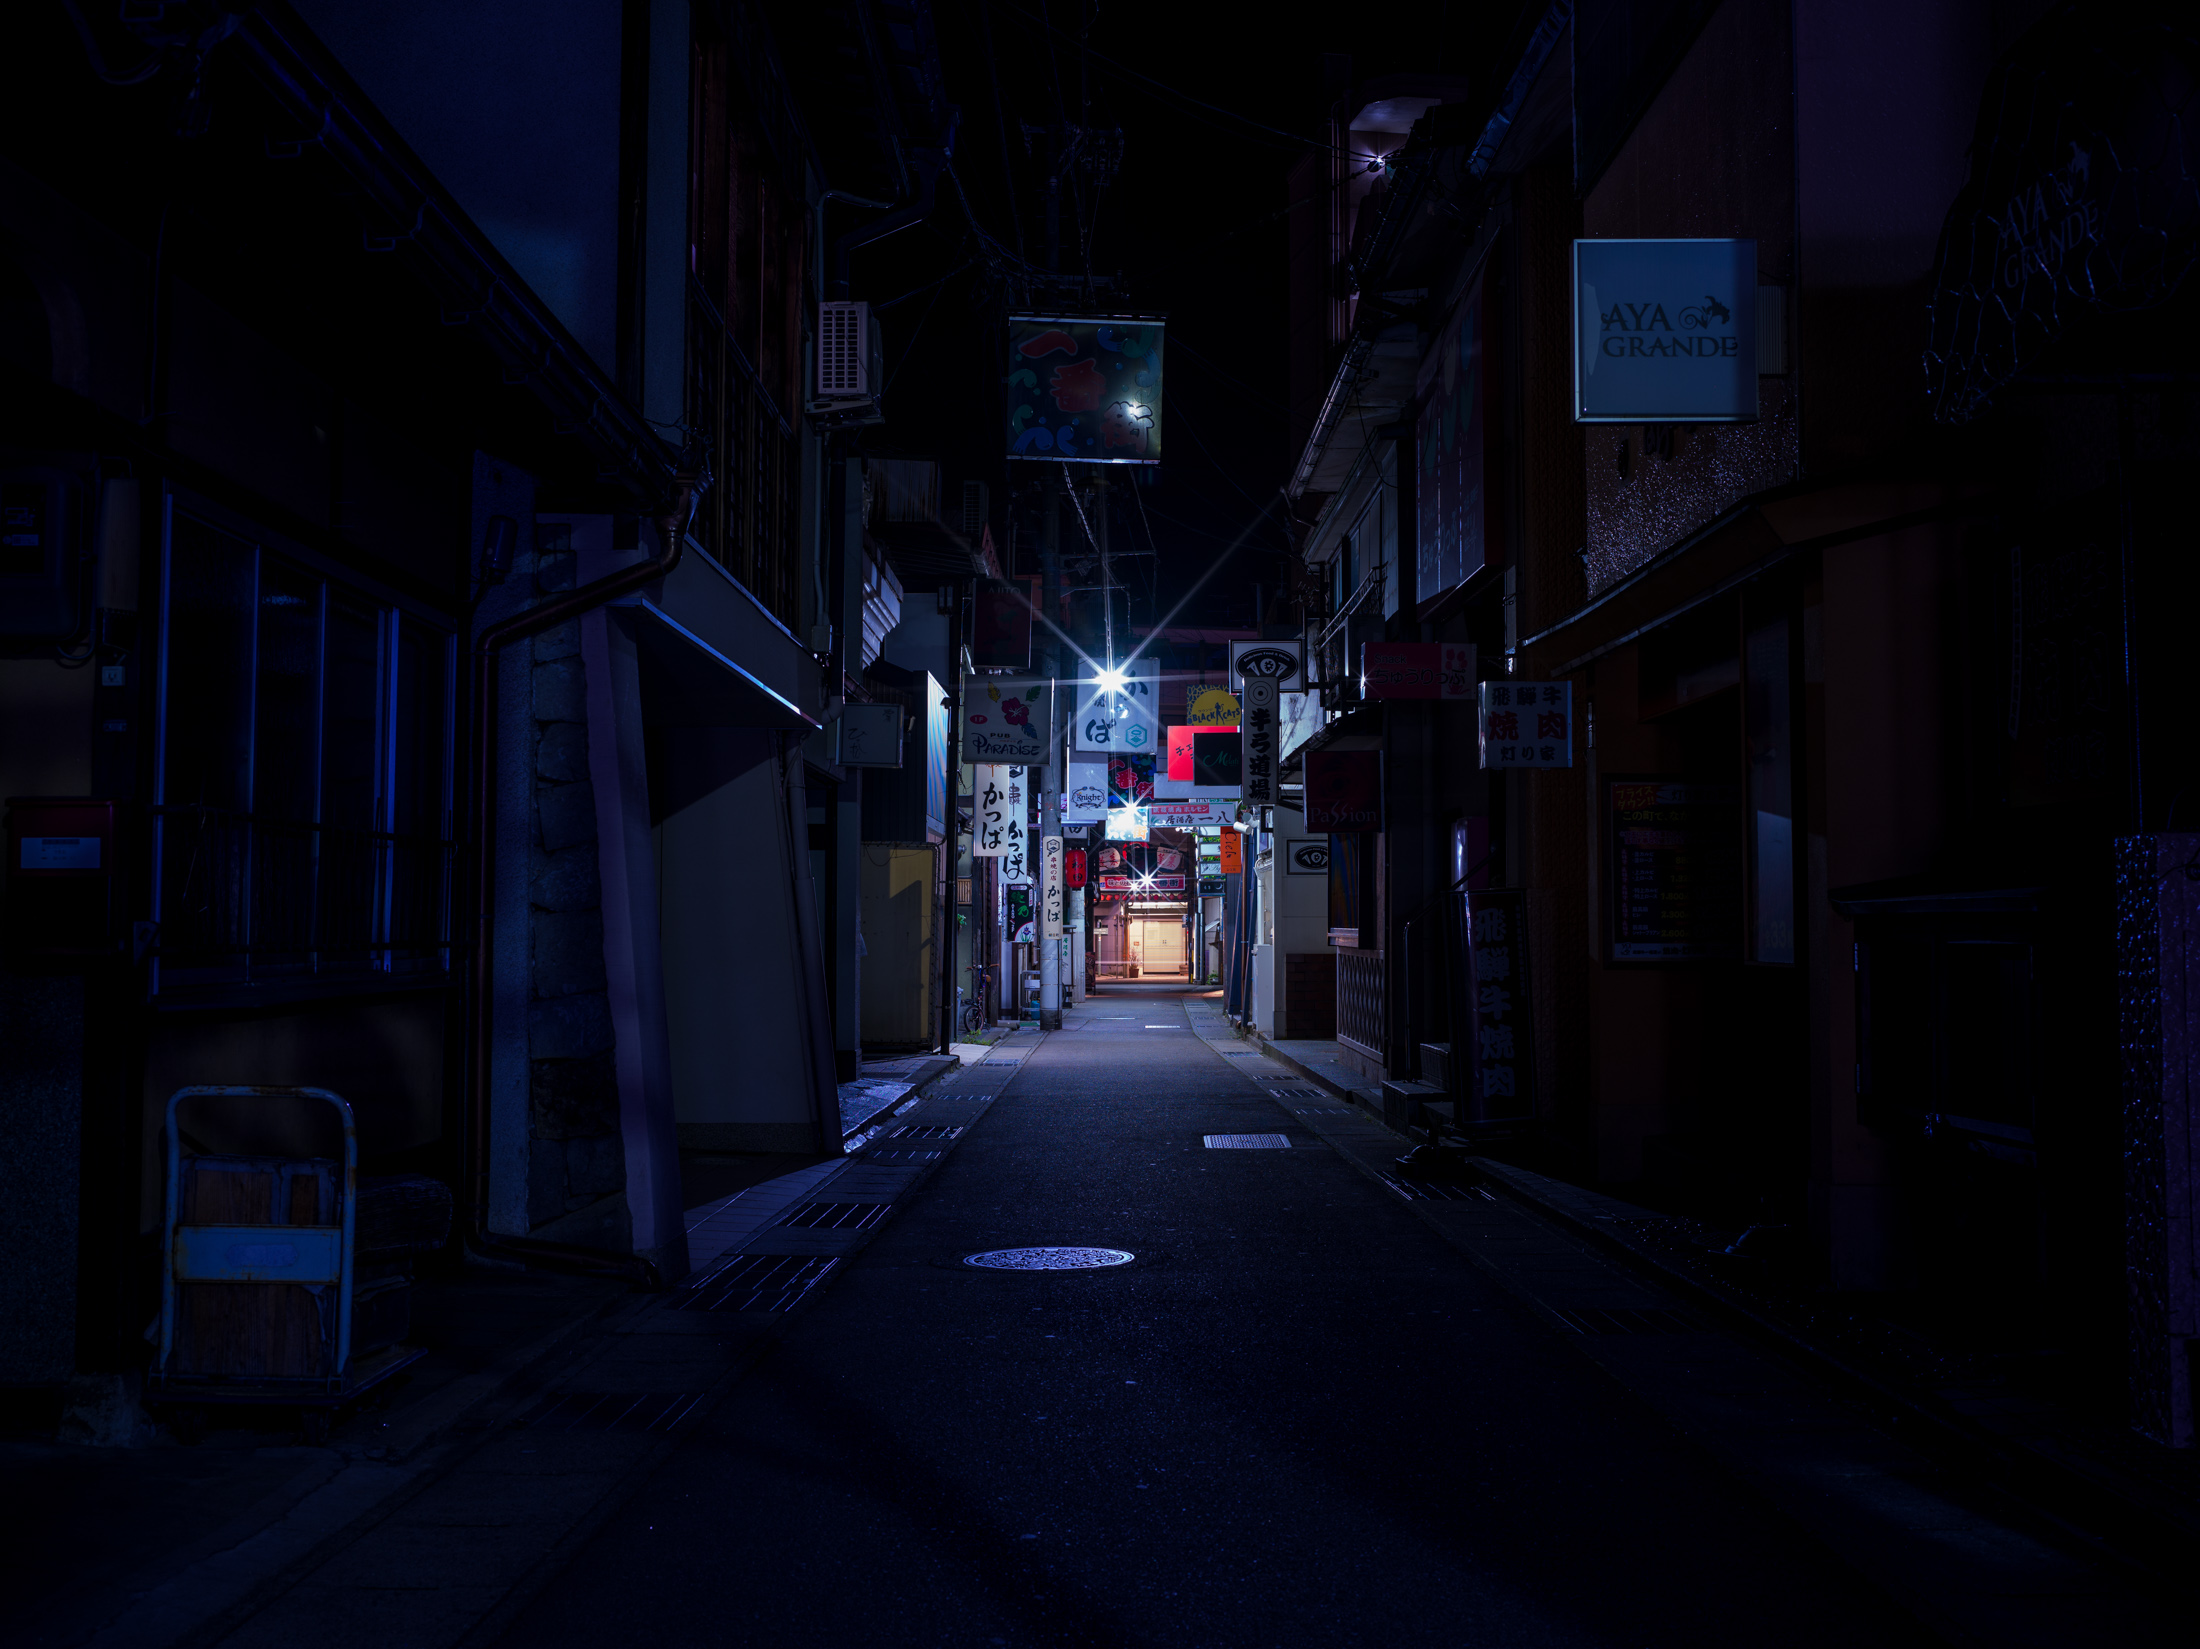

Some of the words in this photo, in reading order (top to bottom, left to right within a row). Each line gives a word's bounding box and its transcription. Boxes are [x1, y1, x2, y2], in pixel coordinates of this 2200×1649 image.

[1601, 303, 1674, 331] AYA
[1602, 336, 1738, 358] GRANDE
[1374, 653, 1407, 664] Snack
[1374, 668, 1466, 685] ちゅうりっぷ
[1192, 711, 1216, 723] BLACK
[1222, 708, 1240, 719] CATS
[1488, 710, 1567, 740] 焼肉
[1248, 708, 1271, 801] 半弓道場
[1500, 745, 1556, 761] 灯り家
[981, 782, 1005, 850] かっぱ
